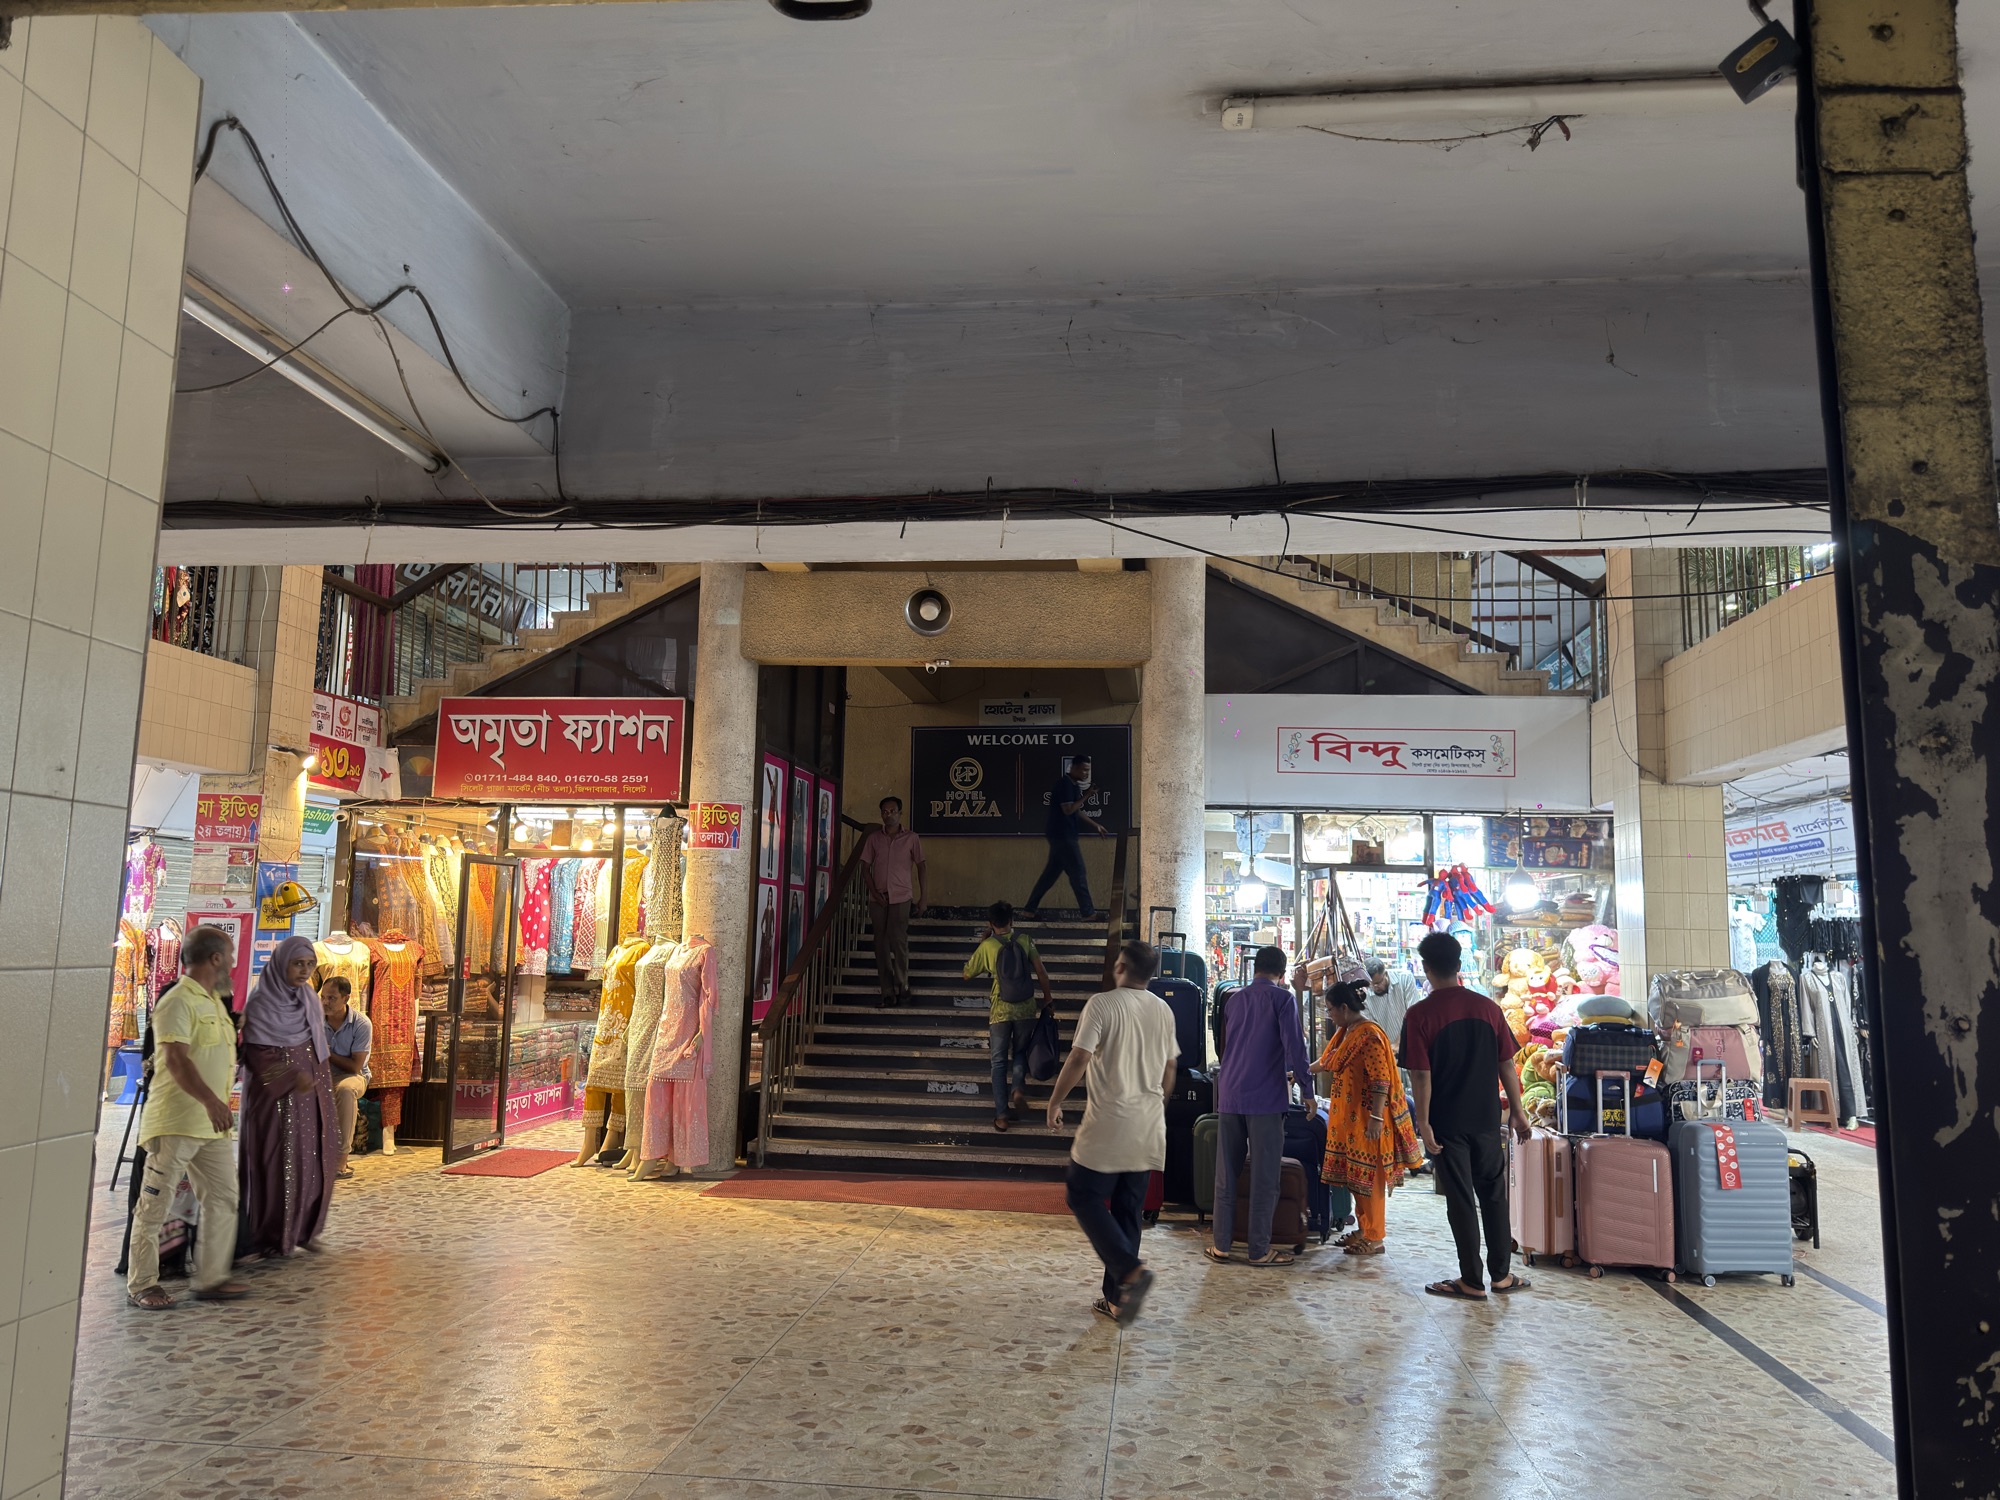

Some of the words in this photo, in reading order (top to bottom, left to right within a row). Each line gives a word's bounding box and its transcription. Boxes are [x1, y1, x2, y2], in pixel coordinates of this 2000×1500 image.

[984, 702, 1024, 715] হোটেল
[1028, 704, 1056, 715] প্লাজা
[335, 725, 353, 741] নগদ
[448, 709, 553, 771] অমৃতা
[558, 709, 674, 754] ফ্যাশন
[967, 734, 1048, 746] WELCOME
[1053, 734, 1075, 745] TO
[1306, 732, 1409, 770] বিন্দু
[1410, 744, 1486, 764] কসমেটিকস্
[474, 774, 533, 783] 01711-484
[536, 774, 561, 784] 840,
[564, 775, 618, 784] 01670-58
[621, 776, 649, 784] 2591
[946, 791, 986, 800] HOTEL
[198, 799, 213, 818] মা
[930, 801, 1001, 817] PLAZA
[194, 825, 211, 841] (২য়
[215, 826, 246, 841] তলায়)
[533, 1086, 563, 1107] ফ্যাশন
